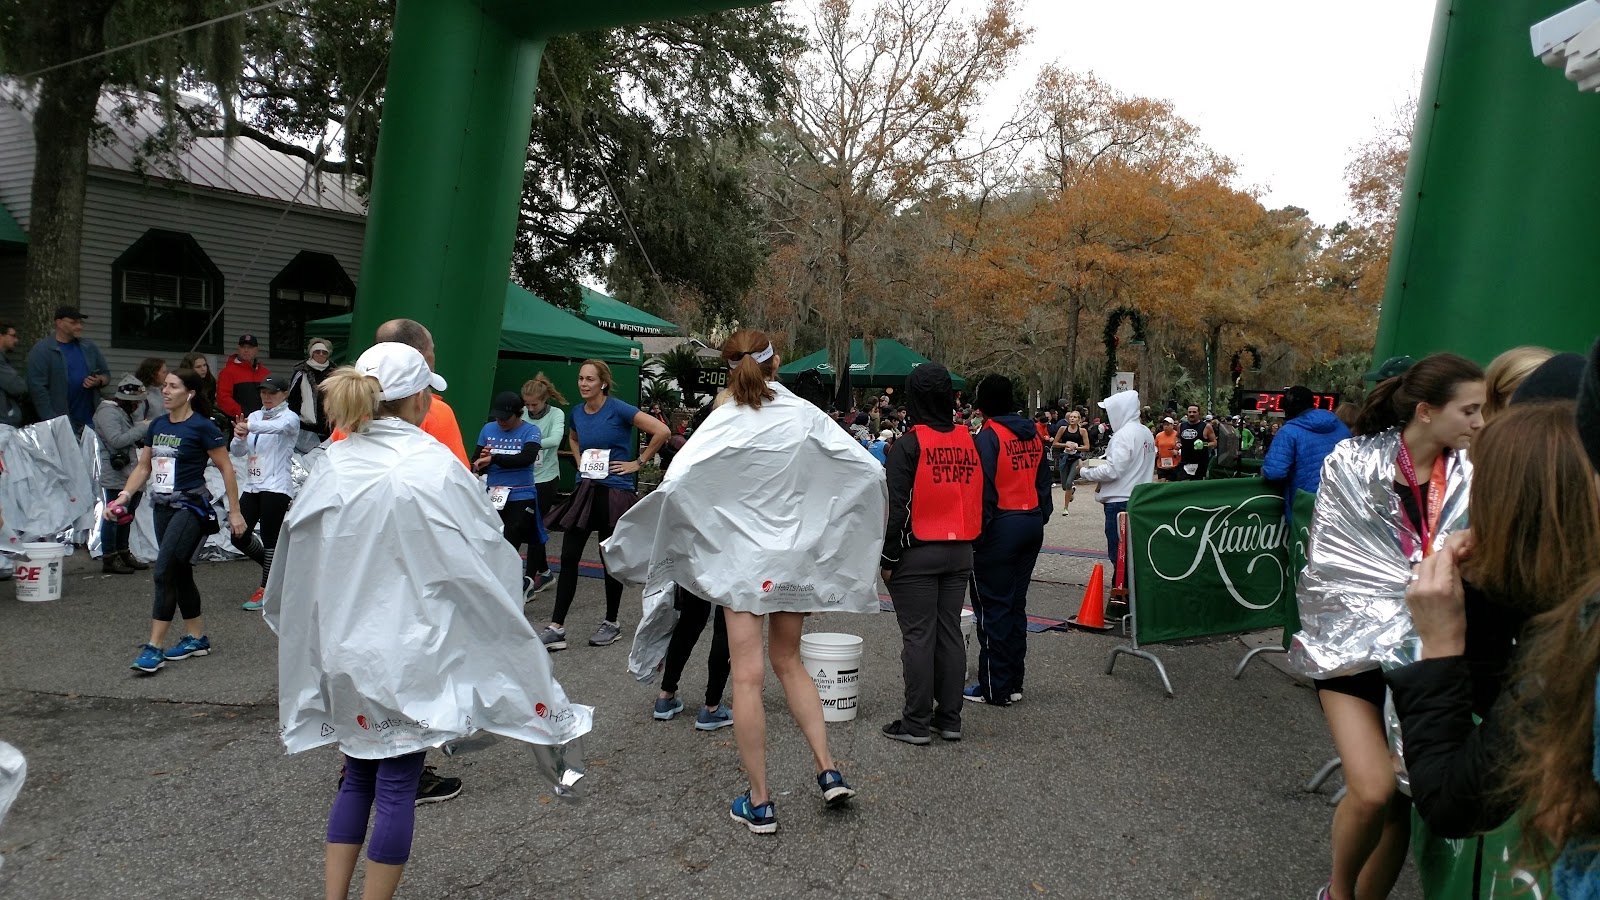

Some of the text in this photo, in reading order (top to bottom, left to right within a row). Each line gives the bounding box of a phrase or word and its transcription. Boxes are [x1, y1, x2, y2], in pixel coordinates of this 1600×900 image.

[620, 323, 661, 334] REGISTRATION
[1003, 437, 1042, 457] MEDICAL
[925, 447, 978, 466] MEDICAL
[1011, 453, 1040, 471] STAFF
[584, 462, 605, 471] 1589
[932, 466, 974, 485] STAFF
